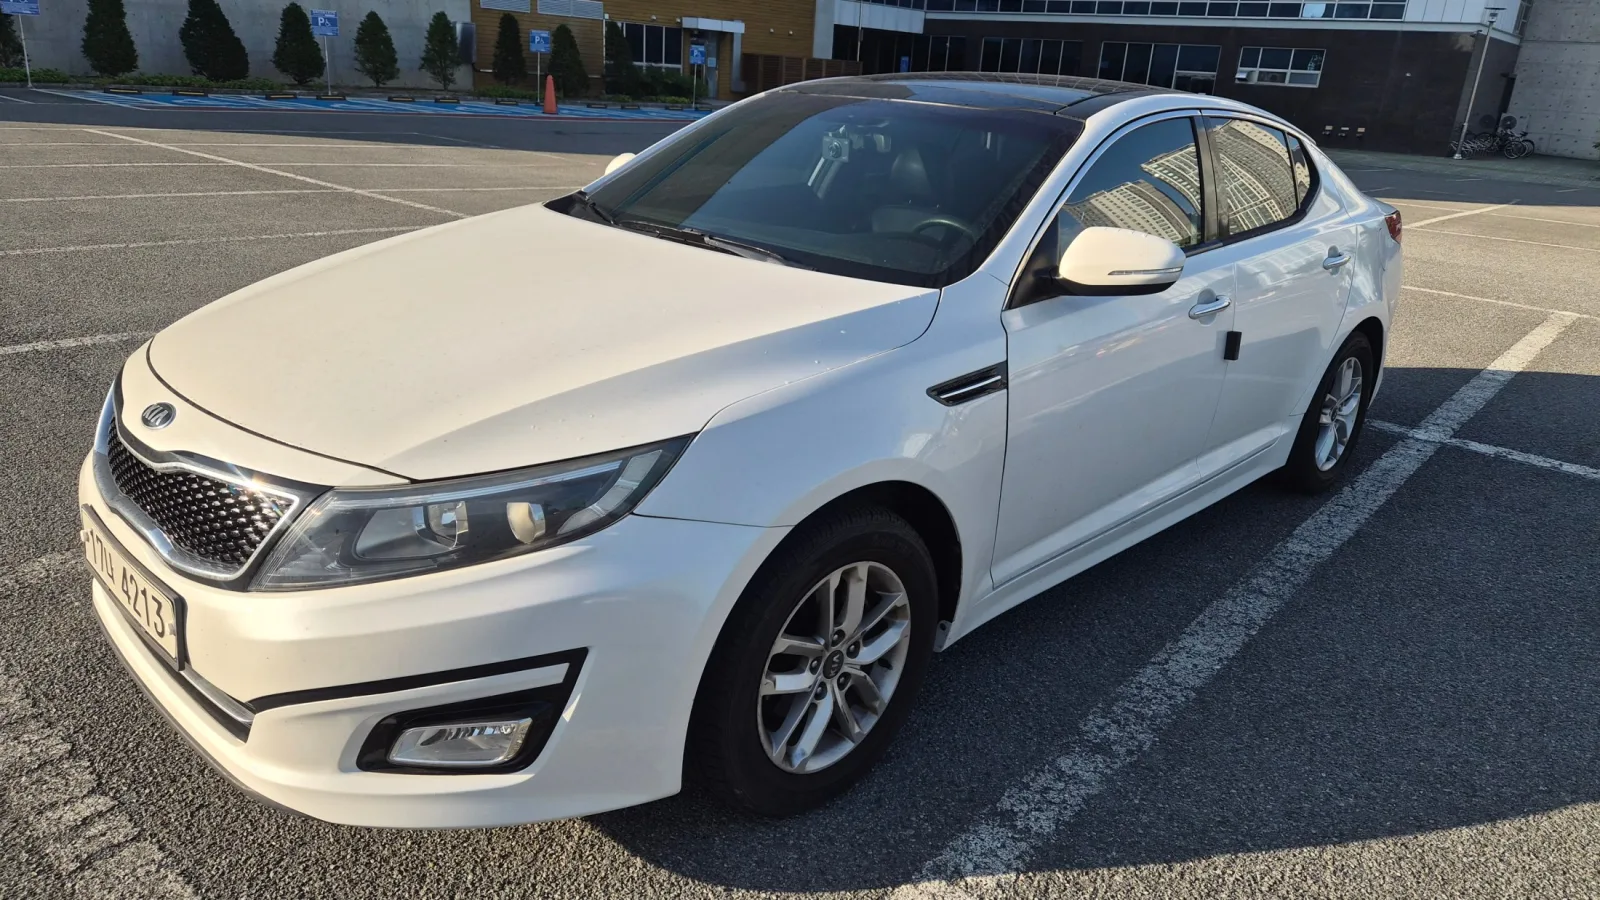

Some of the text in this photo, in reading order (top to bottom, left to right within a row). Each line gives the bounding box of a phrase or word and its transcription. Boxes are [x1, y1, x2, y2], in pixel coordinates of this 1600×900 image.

[318, 17, 325, 26] P
[535, 36, 541, 44] P
[121, 566, 165, 638] 4213
